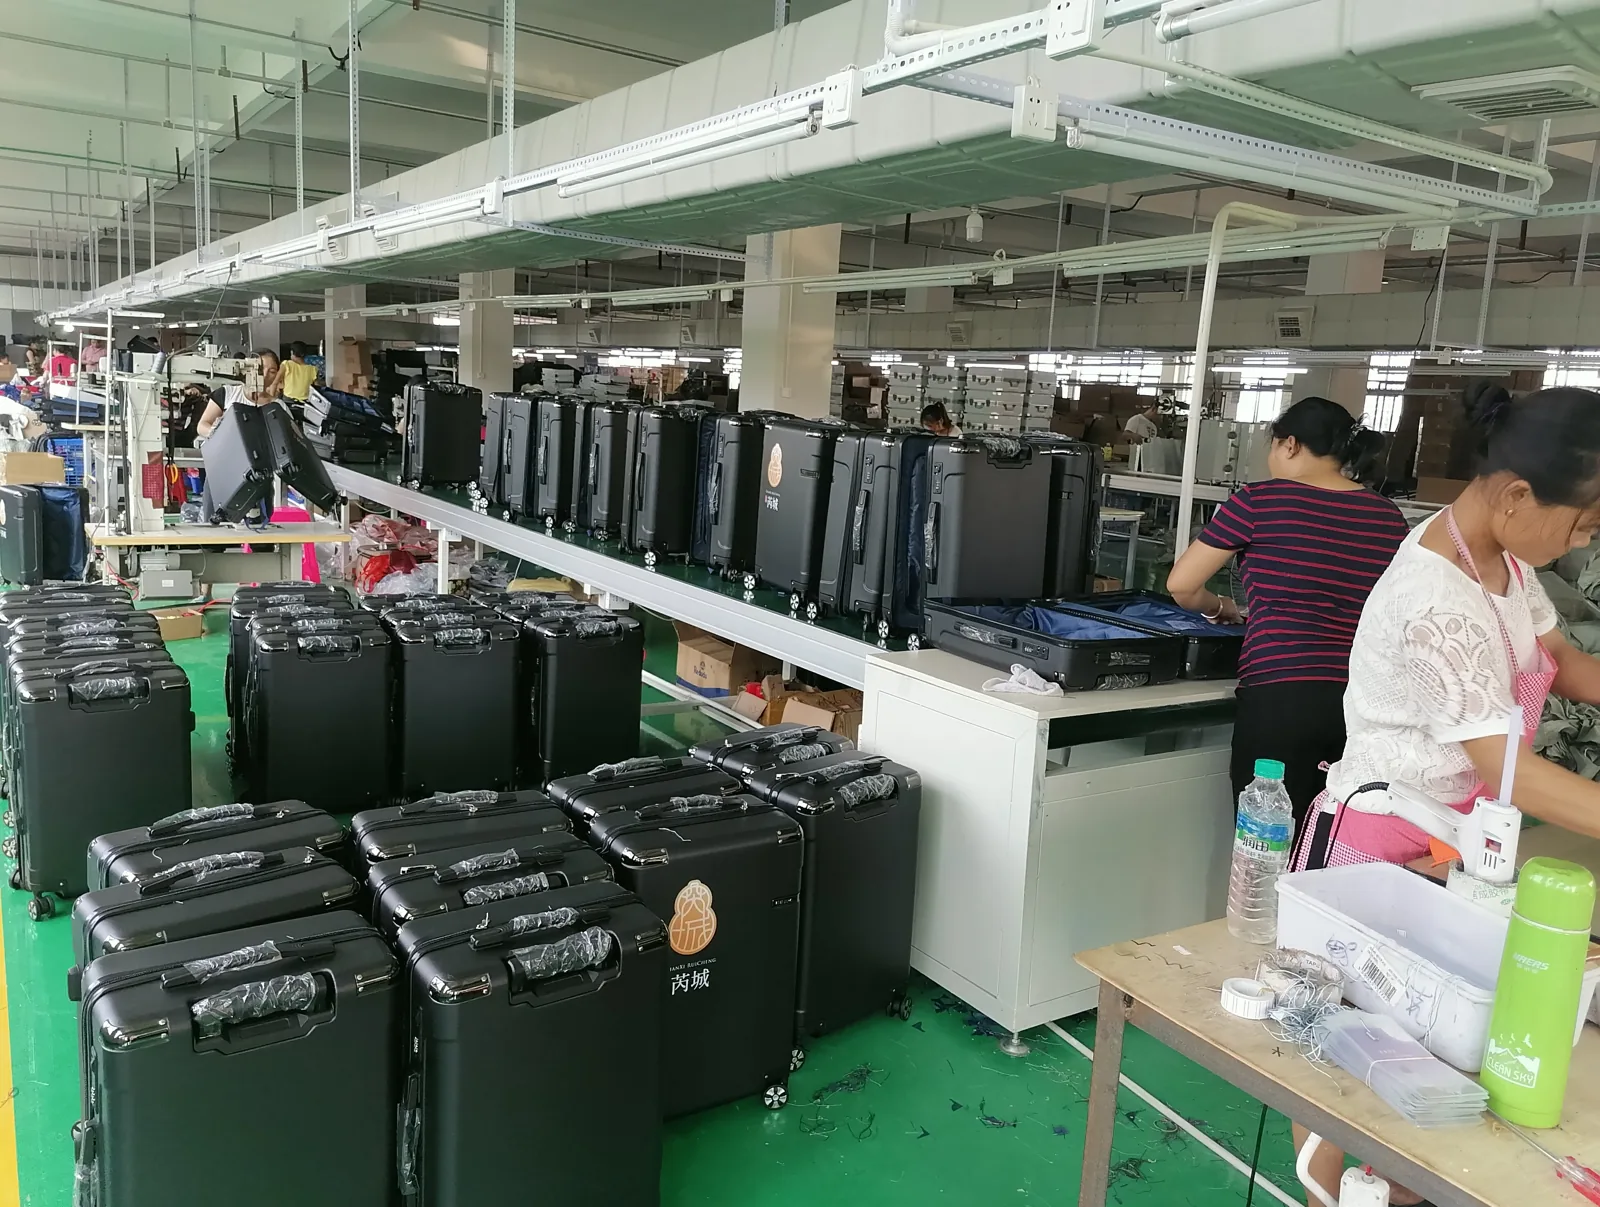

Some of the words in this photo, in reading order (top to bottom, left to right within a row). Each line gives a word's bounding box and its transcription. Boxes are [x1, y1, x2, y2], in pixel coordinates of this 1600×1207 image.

[1242, 836, 1269, 852] 润田
[671, 968, 710, 995] 芮城
[1488, 1056, 1512, 1078] CLEAN
[1512, 1069, 1534, 1085] SKY
